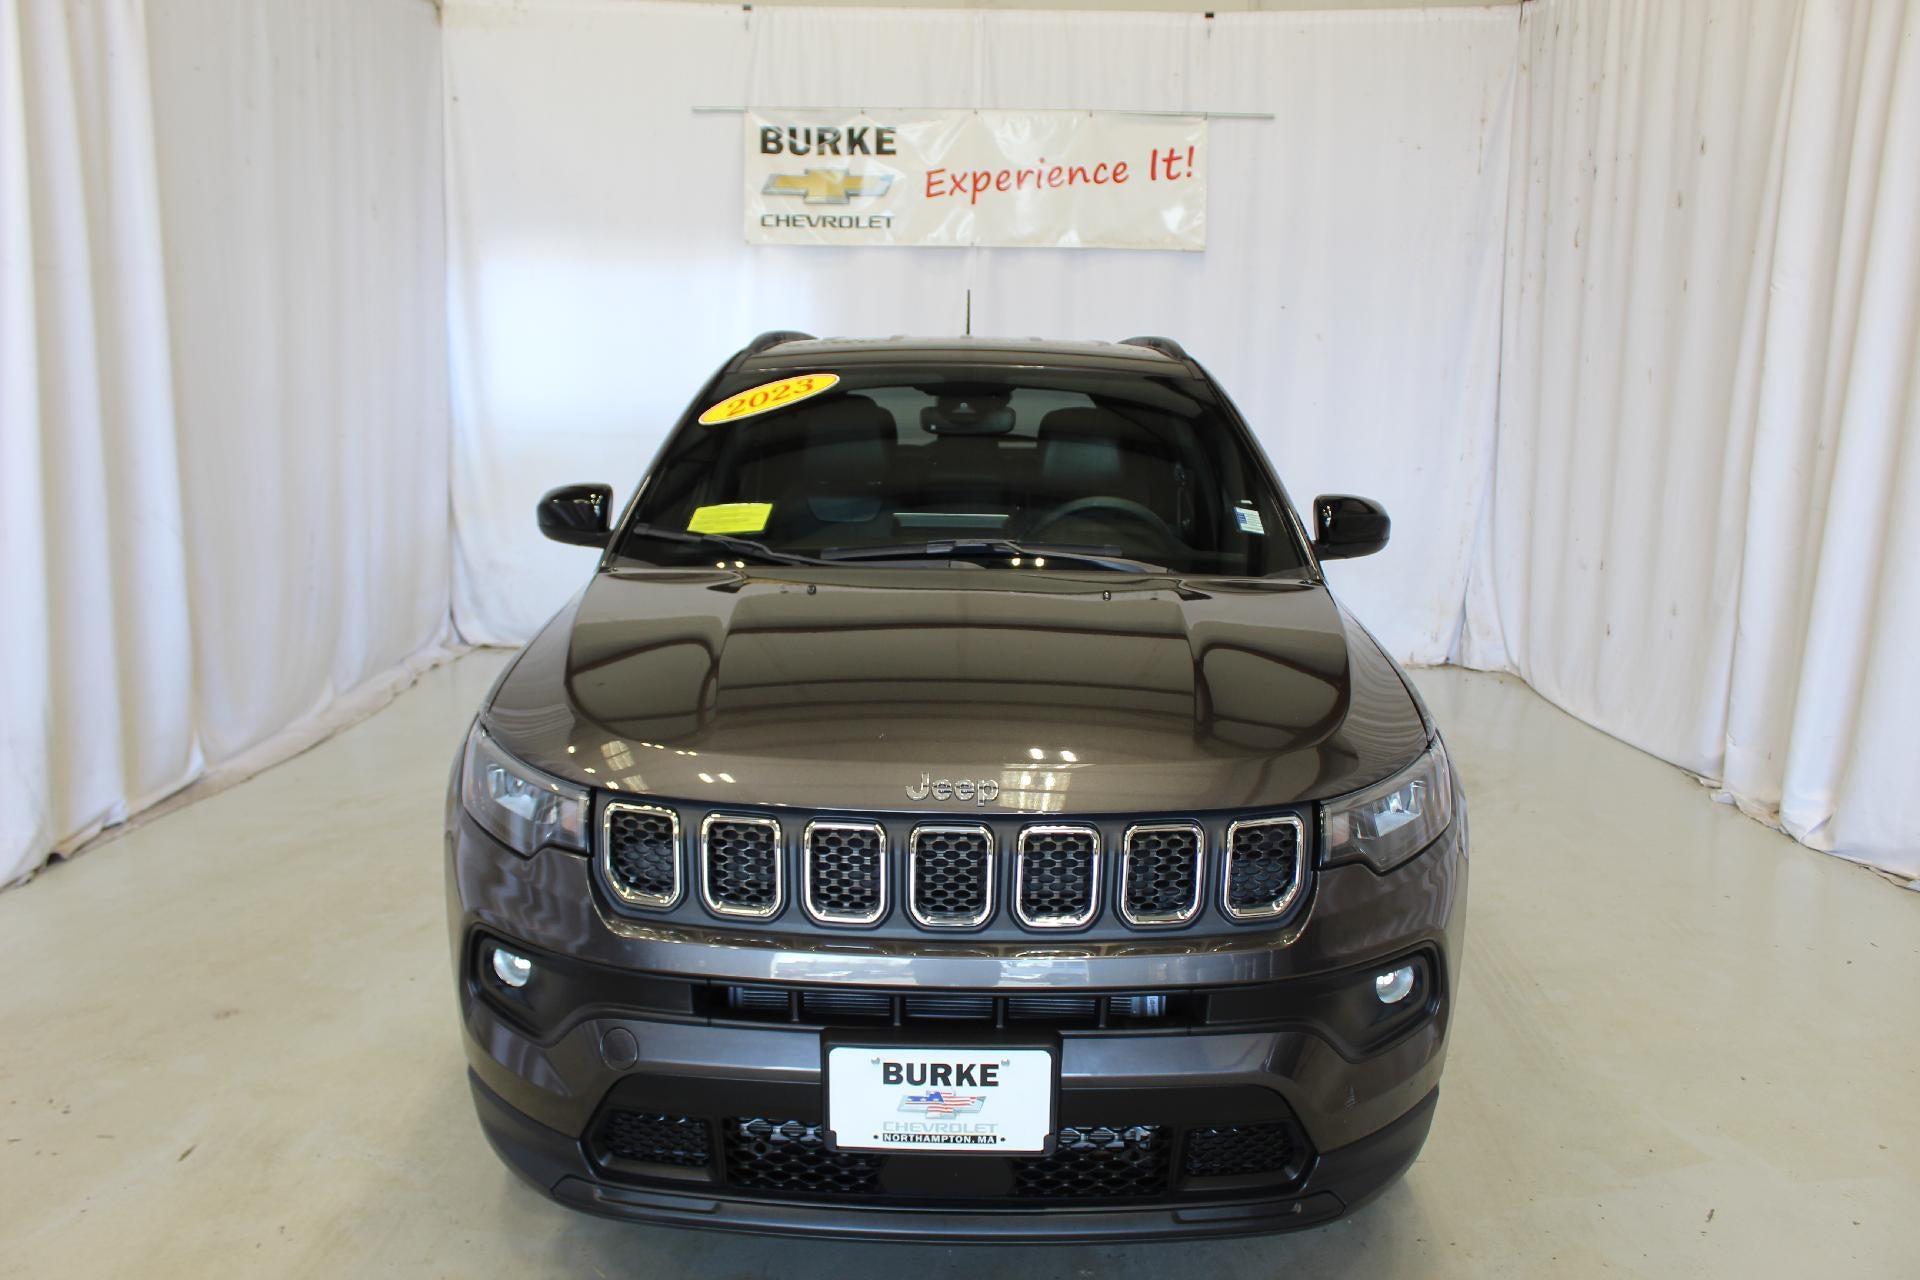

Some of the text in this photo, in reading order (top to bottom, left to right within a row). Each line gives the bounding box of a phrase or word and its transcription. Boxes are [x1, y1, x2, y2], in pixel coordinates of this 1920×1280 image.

[760, 126, 896, 155] BURKE
[925, 145, 1195, 205] Experience It!
[760, 213, 895, 229] CHEVROLET
[726, 378, 814, 417] 2023
[905, 771, 999, 807] Jeep
[882, 1062, 999, 1087] BURKE
[882, 1121, 998, 1133] CHEVROLET
[977, 1135, 995, 1144] MA
